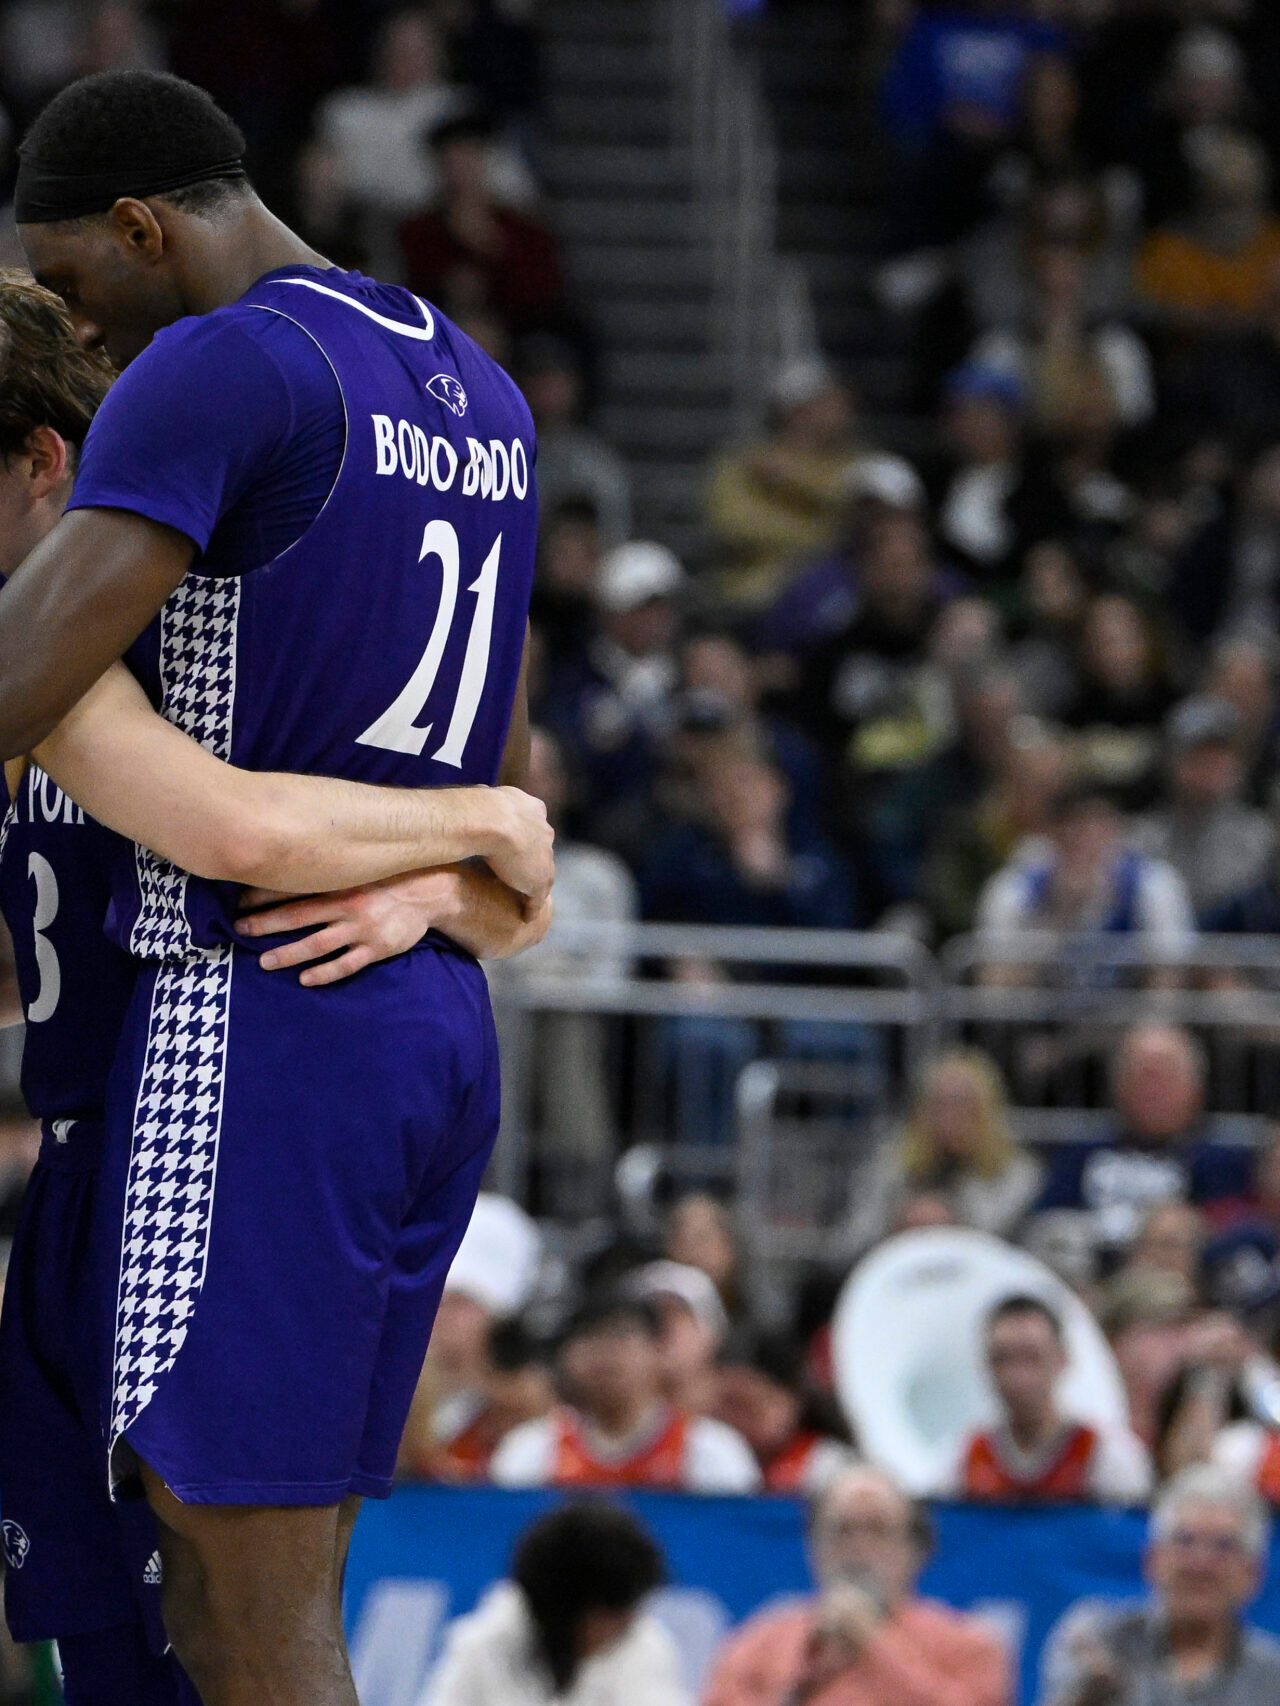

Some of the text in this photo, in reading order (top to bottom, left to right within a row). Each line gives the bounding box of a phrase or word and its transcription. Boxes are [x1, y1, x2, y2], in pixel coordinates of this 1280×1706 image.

[371, 414, 458, 491] BODO
[354, 519, 502, 769] 21
[28, 851, 61, 1023] 3
